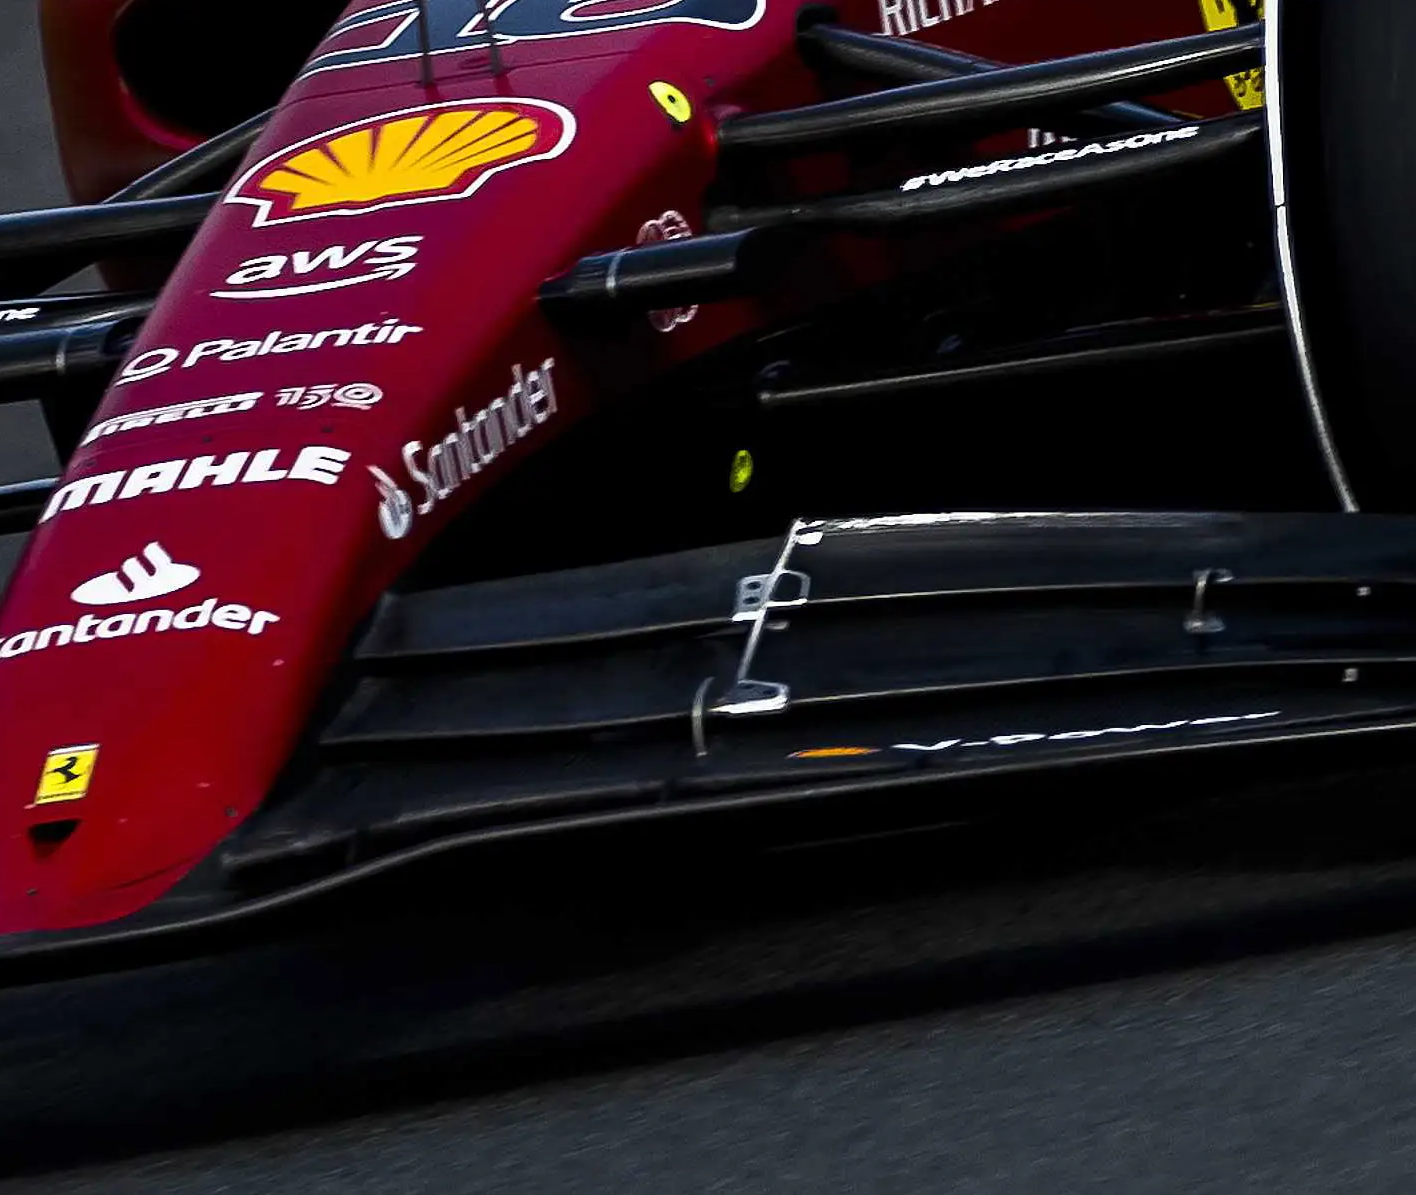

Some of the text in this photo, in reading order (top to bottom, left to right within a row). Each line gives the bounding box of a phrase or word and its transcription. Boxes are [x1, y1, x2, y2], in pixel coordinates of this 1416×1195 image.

[224, 235, 424, 286] aws
[180, 317, 425, 370] Palantir
[415, 355, 560, 517] Santander
[36, 444, 353, 526] MAHLE
